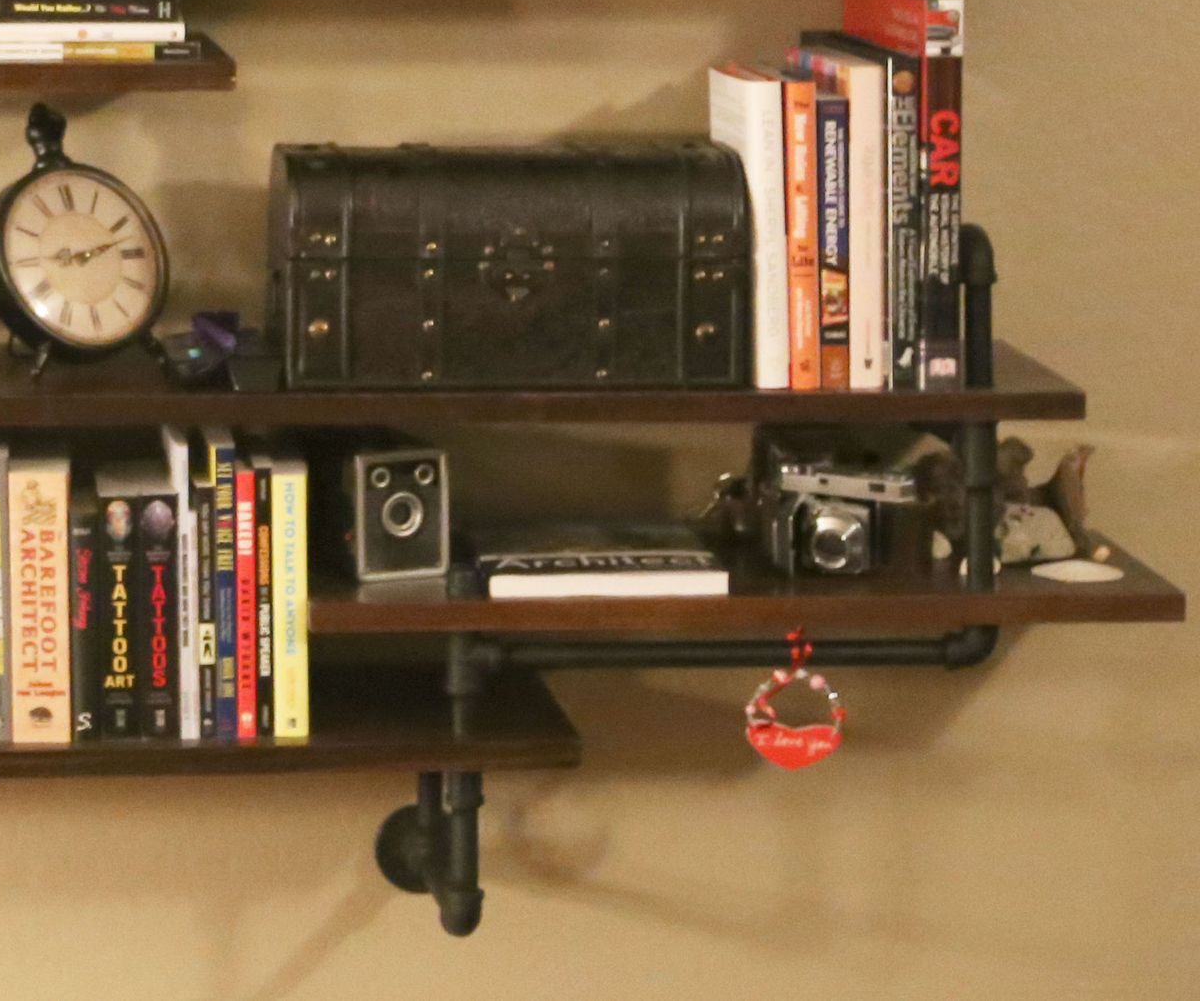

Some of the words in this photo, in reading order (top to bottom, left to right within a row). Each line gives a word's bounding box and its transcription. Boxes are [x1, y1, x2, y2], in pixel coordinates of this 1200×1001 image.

[824, 119, 837, 204] RENEWABLE
[892, 110, 917, 225] Elements
[929, 109, 961, 187] CAR
[824, 208, 838, 266] ENERGY
[216, 462, 234, 479] SET
[216, 484, 234, 510] YOUR
[283, 481, 295, 515] HOW
[216, 515, 234, 544] VOICE
[237, 501, 253, 556] NAKED!
[284, 521, 295, 540] TO
[217, 550, 235, 572] FREE
[259, 525, 270, 585] CONFESSIONS
[284, 542, 296, 573] TALK
[20, 529, 39, 673] ARCHITECT
[39, 530, 57, 673] BAREFOOT
[284, 579, 296, 596] TO
[111, 565, 129, 674] TATTOO
[151, 565, 168, 688] TATTOOS
[260, 603, 271, 636] PUBLIC
[285, 599, 297, 657] ANYONE
[260, 638, 271, 677] SPEAKER
[103, 674, 136, 689] ART
